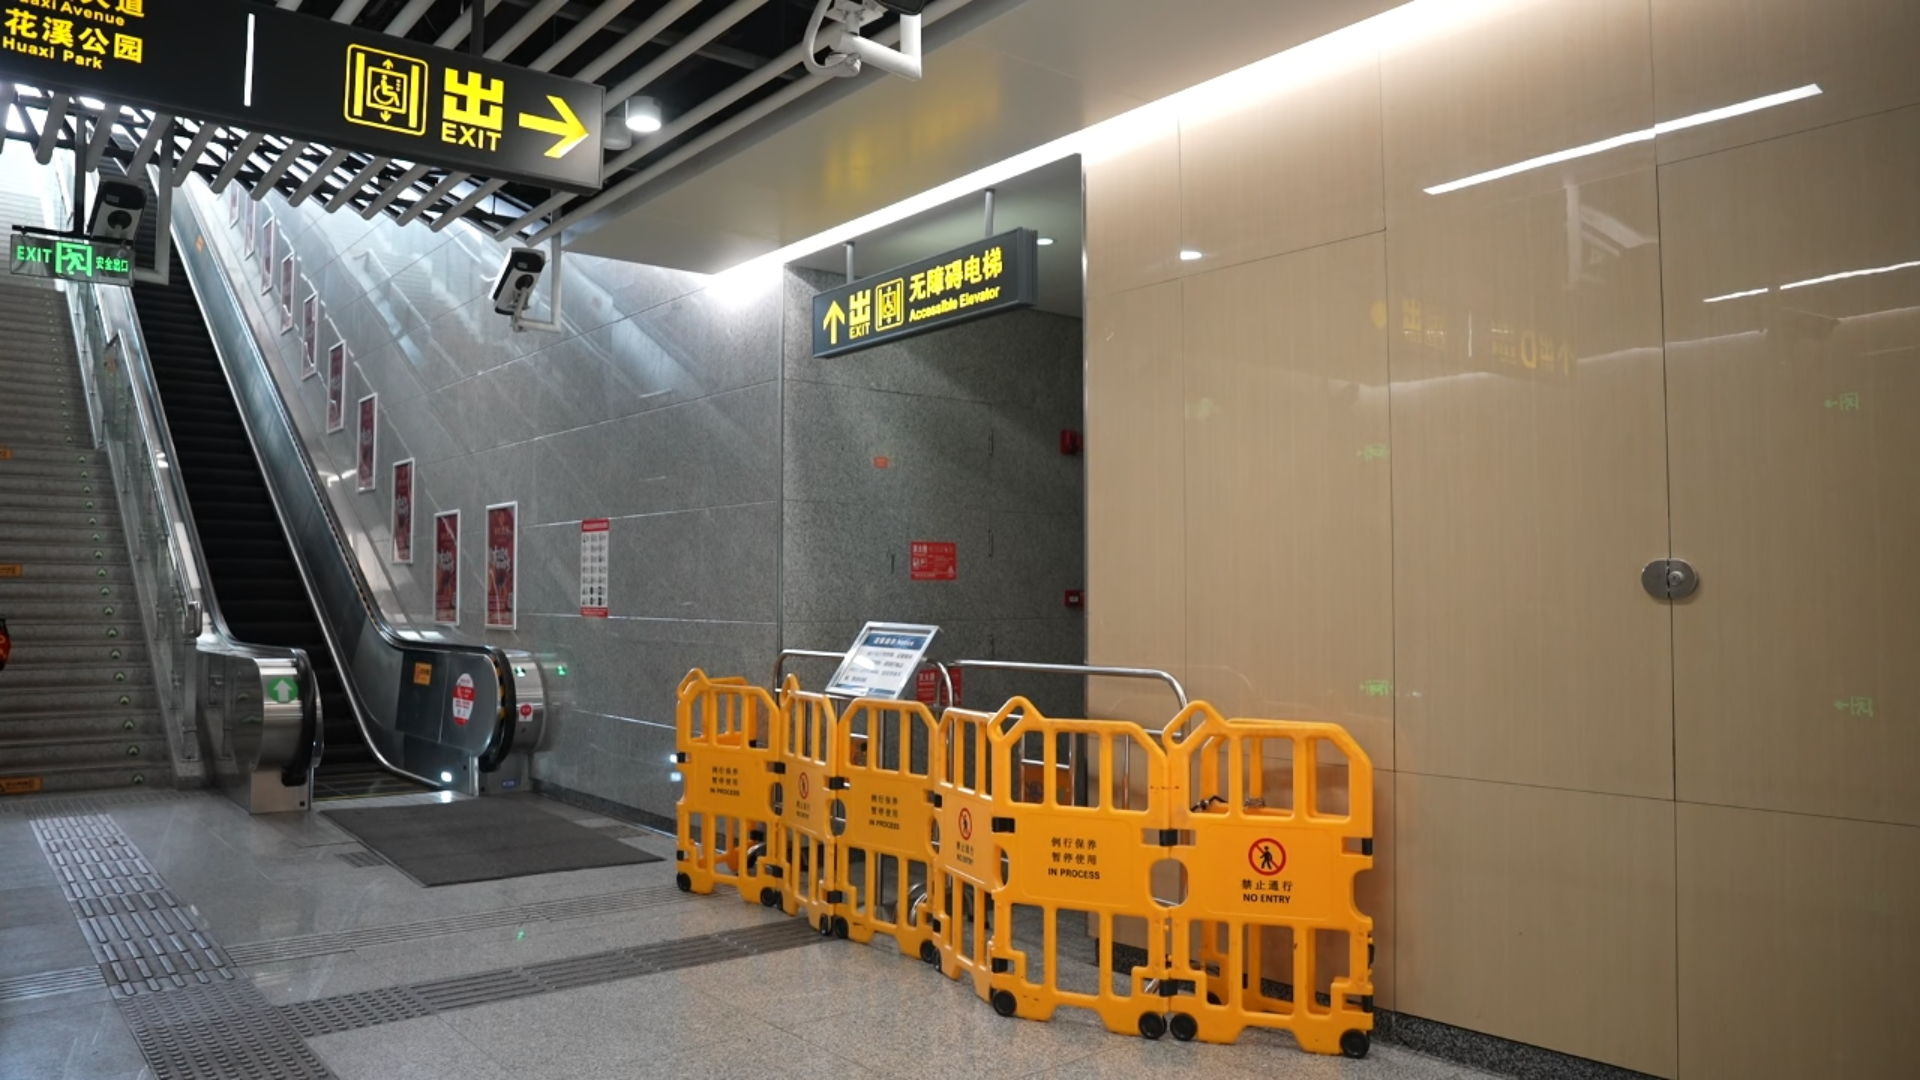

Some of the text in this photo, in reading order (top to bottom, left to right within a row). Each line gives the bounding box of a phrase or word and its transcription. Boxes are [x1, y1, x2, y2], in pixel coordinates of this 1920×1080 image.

[60, 1, 125, 26] Avenue
[4, 8, 143, 63] 花溪公园
[2, 35, 103, 69] Huaxi Park
[443, 67, 504, 131] 出
[441, 121, 502, 152] EXIT
[17, 245, 52, 263] EXIT
[95, 256, 129, 272] 安全出口
[909, 246, 1003, 303] 无障碍电梯
[849, 289, 871, 326] 出
[908, 286, 1001, 323] Accessible Elevator
[849, 322, 871, 340] EXIT
[1052, 851, 1097, 866] 暂停使用
[1048, 867, 1101, 880] IN PROCESS
[1242, 879, 1293, 892] 禁止通行
[1242, 893, 1291, 905] NO ENTRY
